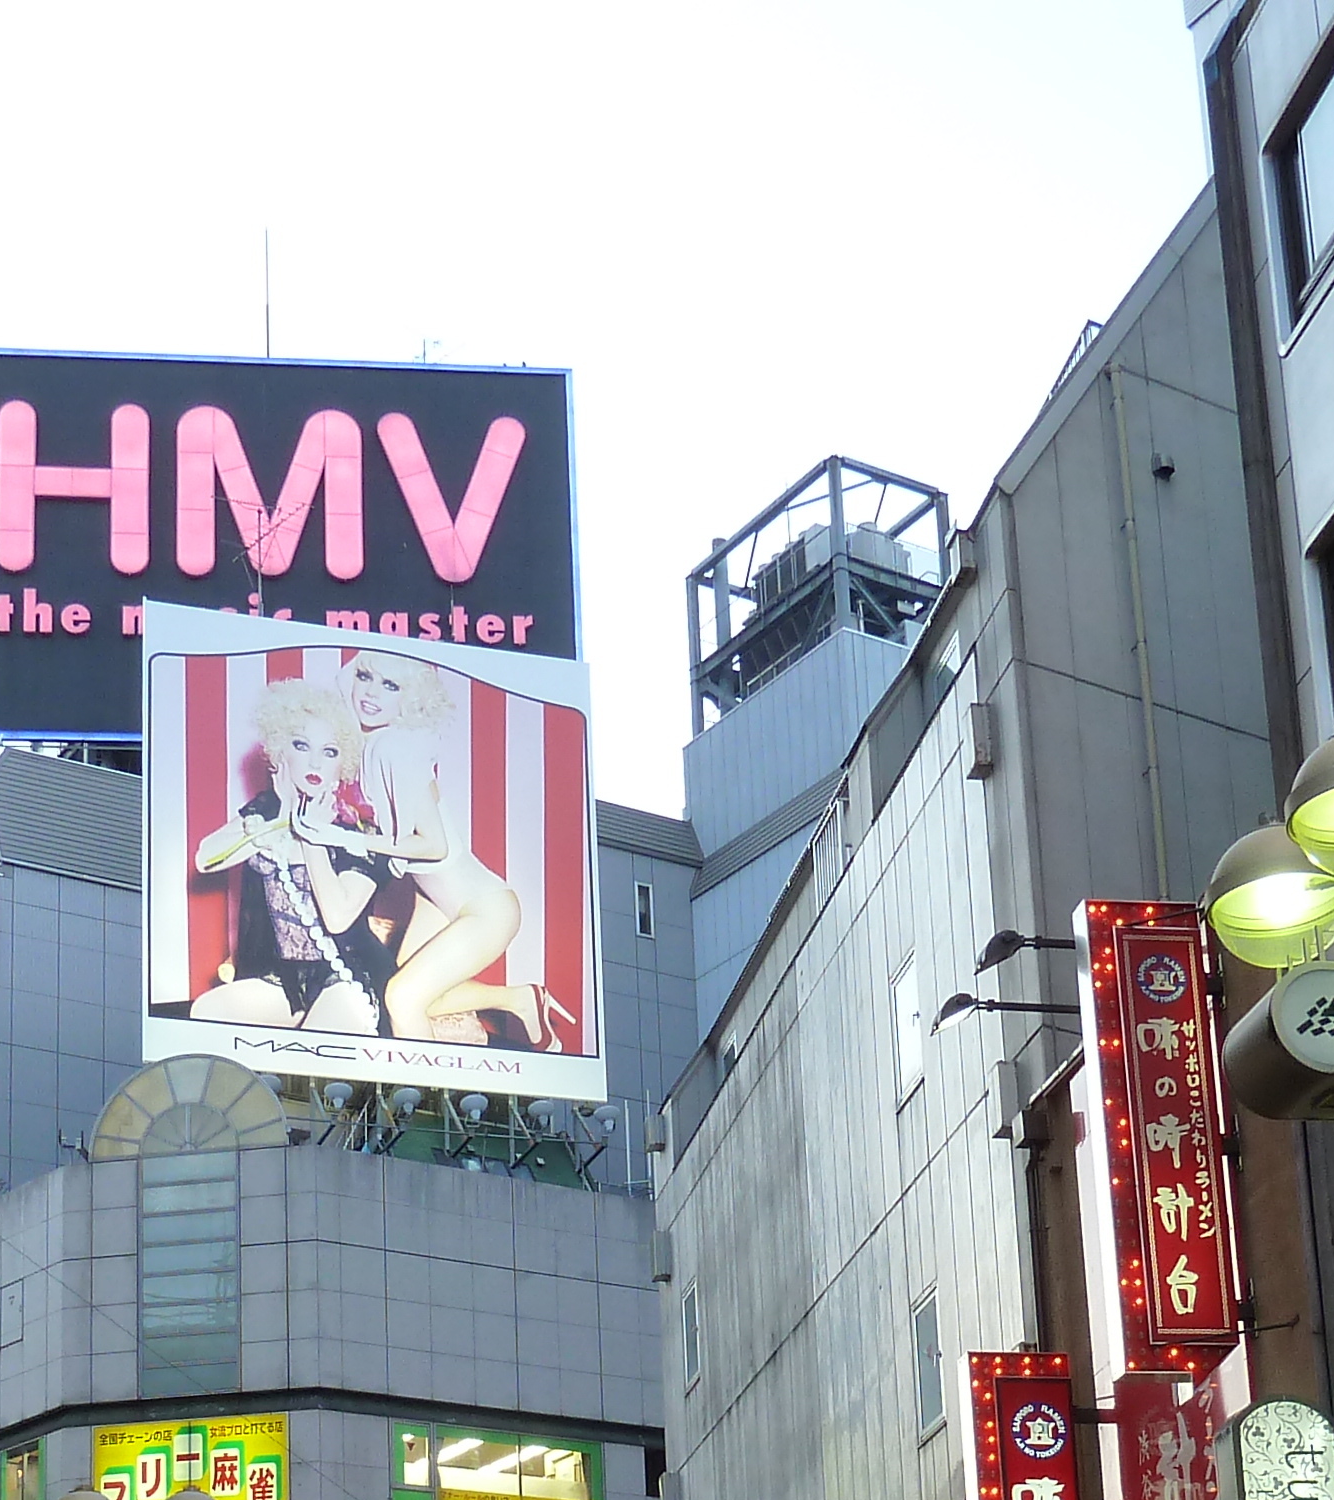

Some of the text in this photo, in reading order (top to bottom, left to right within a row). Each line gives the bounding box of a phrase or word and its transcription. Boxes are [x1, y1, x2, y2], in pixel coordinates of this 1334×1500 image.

[325, 604, 534, 646] master
[1136, 1016, 1202, 1316] 味の時計台
[1180, 1019, 1216, 1240] サッポロこだわりラーメン
[99, 1429, 173, 1446] 全国チェーンの店
